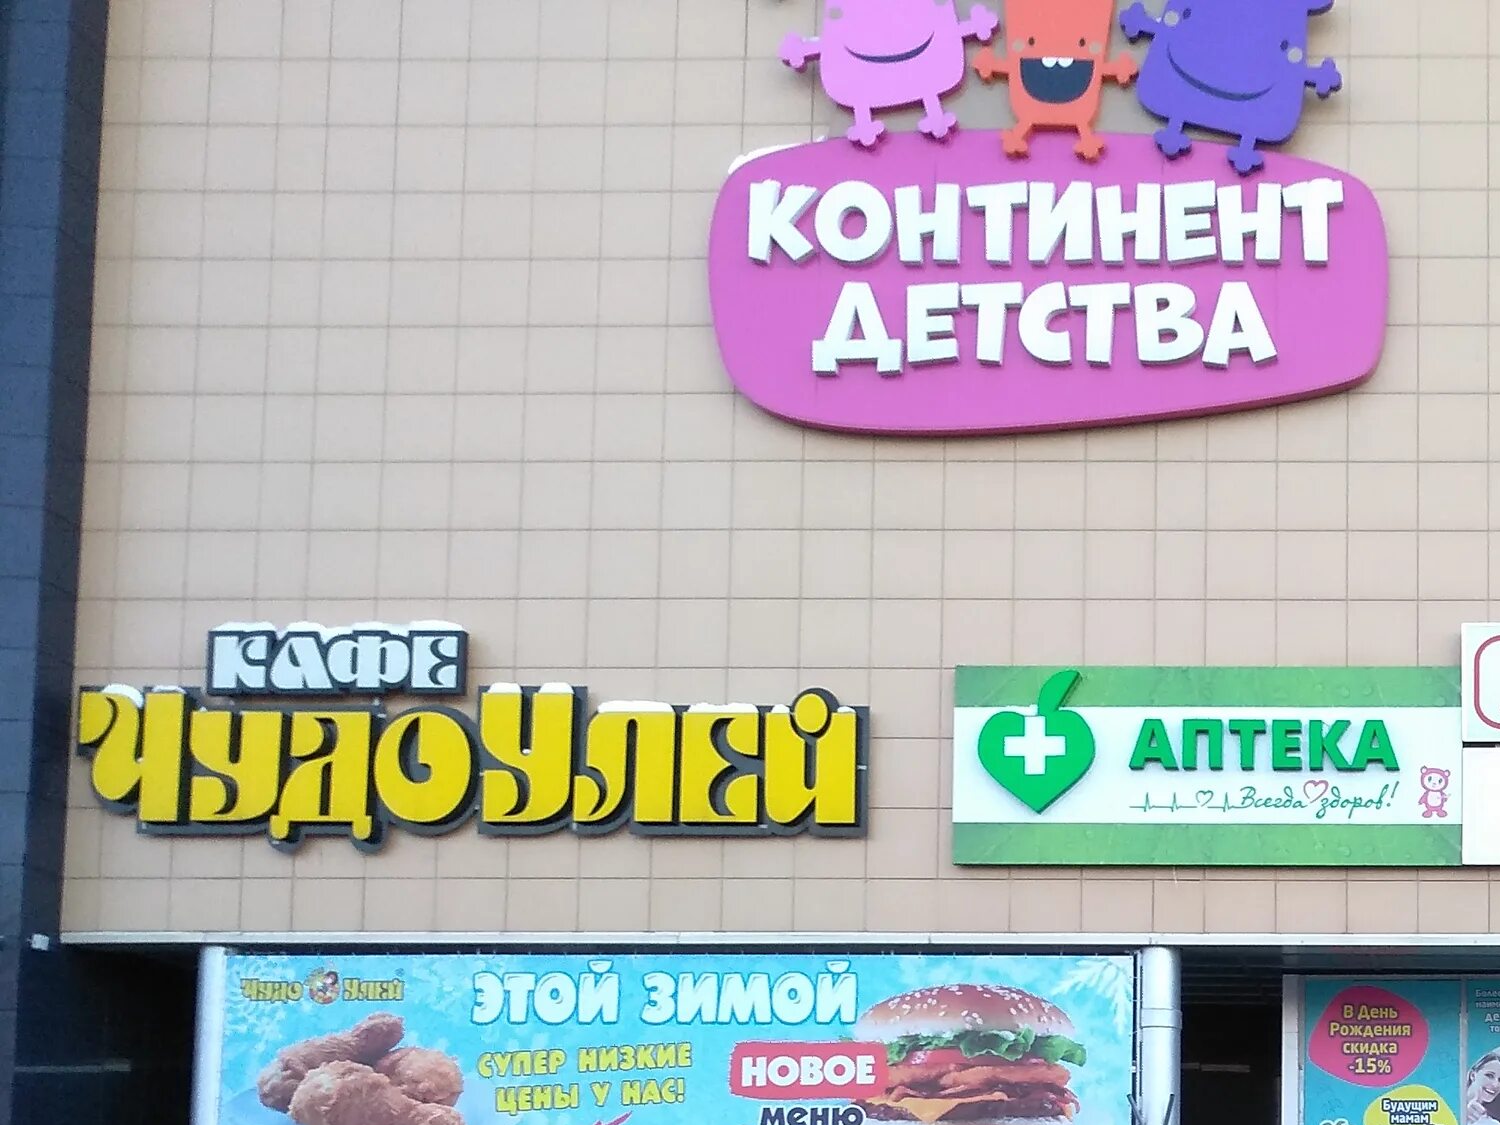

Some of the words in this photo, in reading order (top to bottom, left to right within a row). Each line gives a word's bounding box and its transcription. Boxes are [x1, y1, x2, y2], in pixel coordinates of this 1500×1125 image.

[746, 177, 1344, 267] КОНТИНЕНТ
[811, 280, 1277, 376] ДЕТСТВА
[210, 628, 465, 694] КАФЕ
[1128, 718, 1401, 772] АПТЕКА
[1235, 785, 1308, 811] Всегда
[1318, 780, 1401, 819] здоров!
[471, 960, 622, 1025] ЭТОЙ
[642, 960, 859, 1025] ЗИМОЙ
[1329, 1022, 1411, 1037] Рождения
[1343, 1005, 1354, 1018] В
[1358, 1005, 1398, 1020] День
[478, 1048, 567, 1079] СУПЕР
[578, 1042, 693, 1072] НИЗКИЕ
[1343, 1041, 1398, 1054] скидка
[1349, 1058, 1391, 1074] -15%
[741, 1056, 876, 1087] НОВОЕ
[496, 1083, 578, 1115] ЦЕНЫ
[594, 1083, 612, 1107] У
[622, 1078, 686, 1105] НАС!
[1382, 1098, 1438, 1112] Будущим
[1390, 1114, 1429, 1124] мамам
